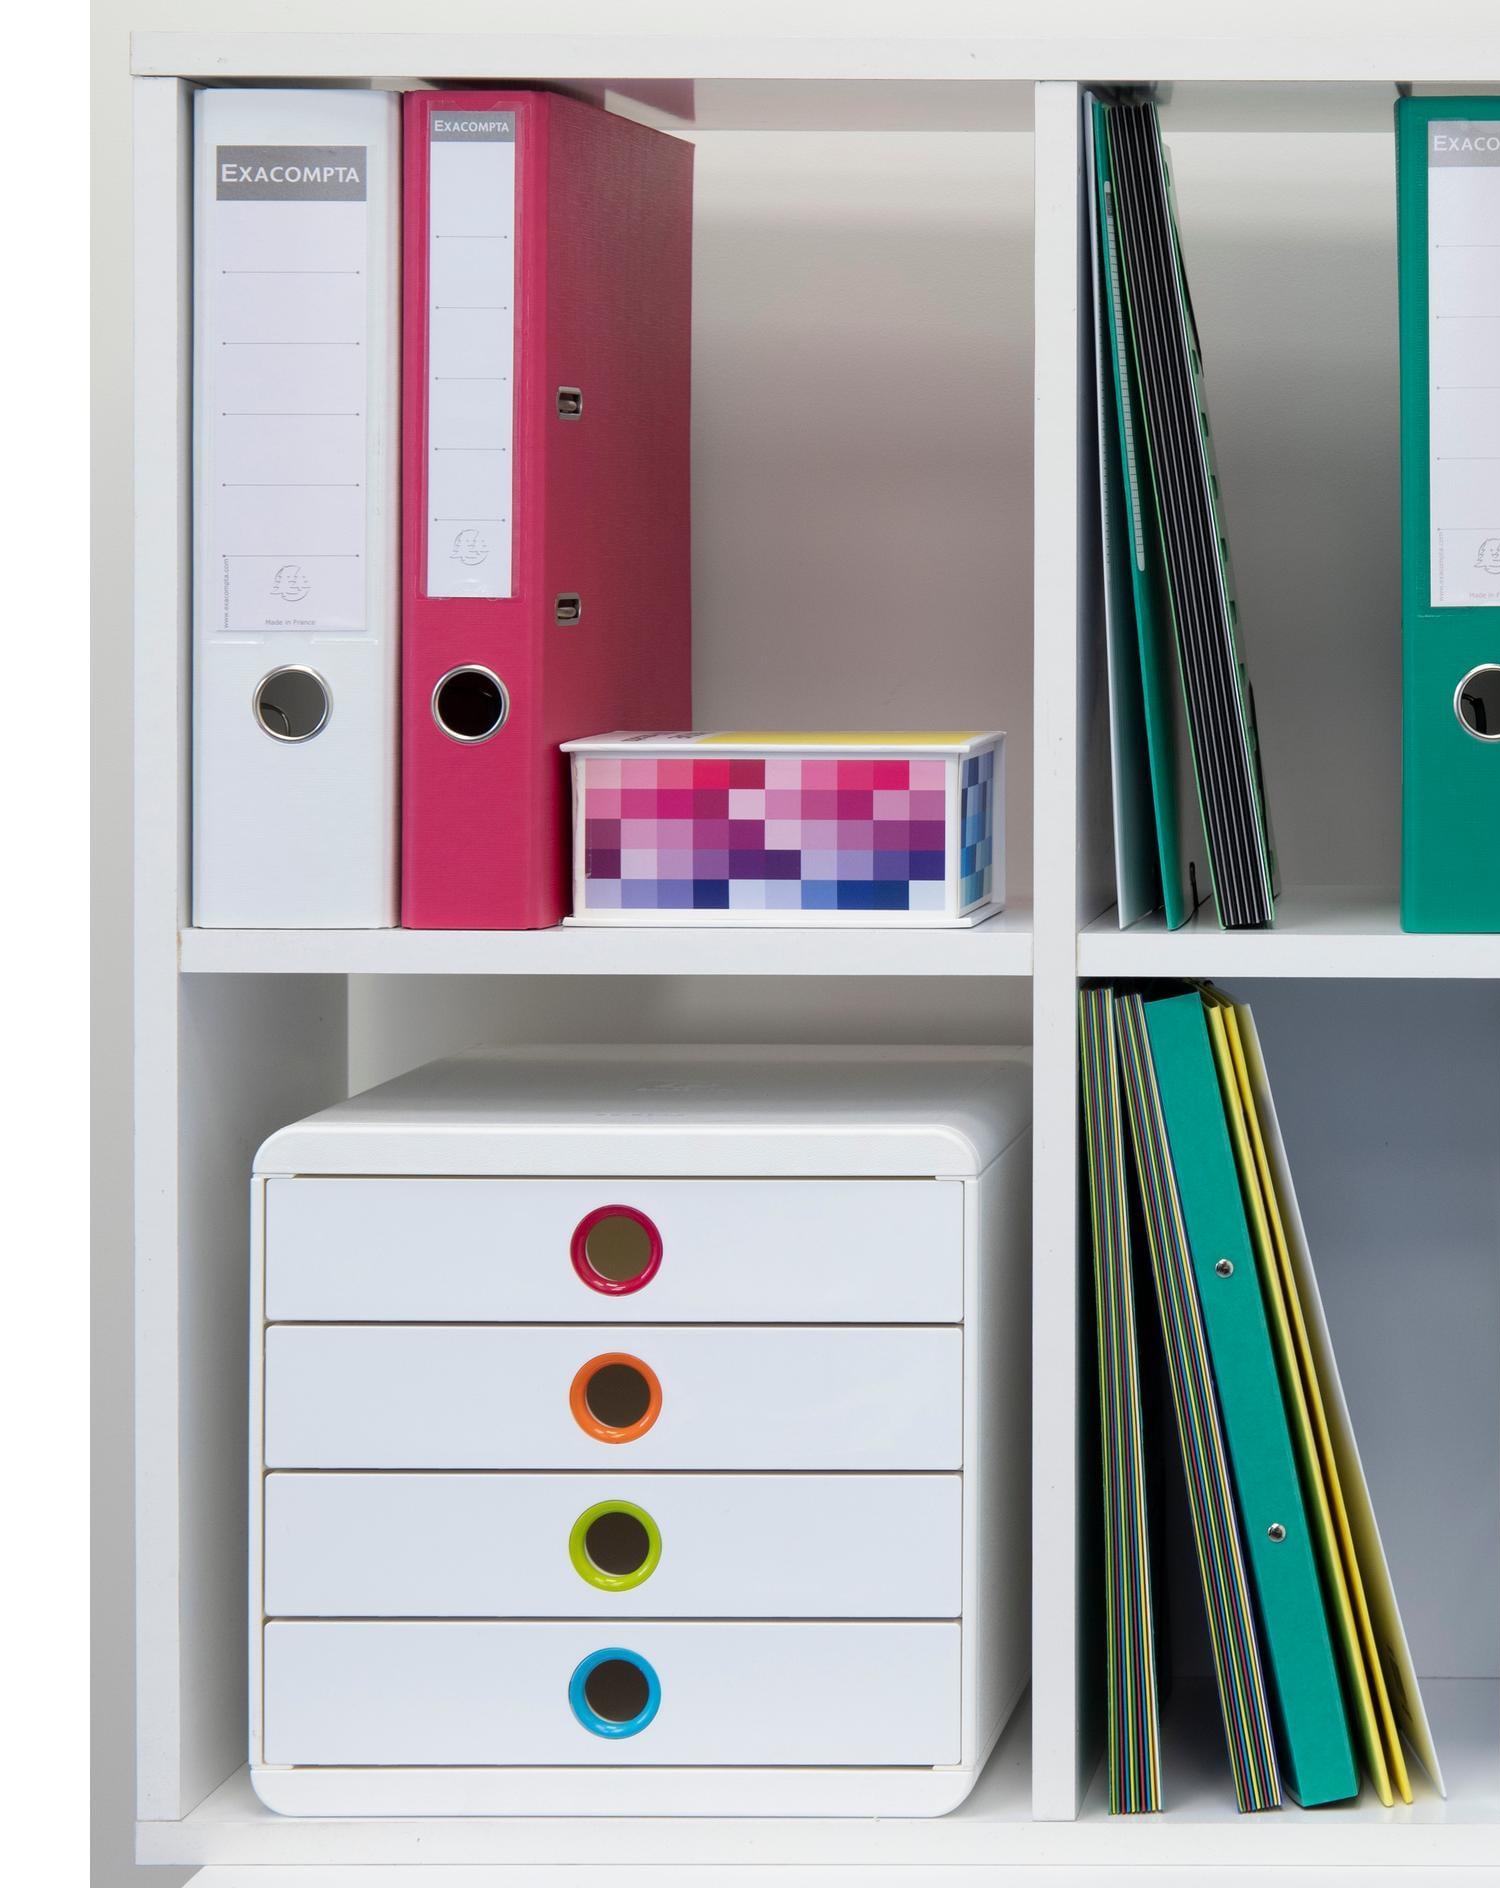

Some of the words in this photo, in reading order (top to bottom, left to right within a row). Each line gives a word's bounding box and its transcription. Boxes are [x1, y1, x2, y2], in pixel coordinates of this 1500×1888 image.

[433, 119, 510, 134] EXACOMPTA
[221, 163, 361, 184] EXACOMPTA
[265, 618, 283, 626] Made
[293, 618, 316, 626] France
